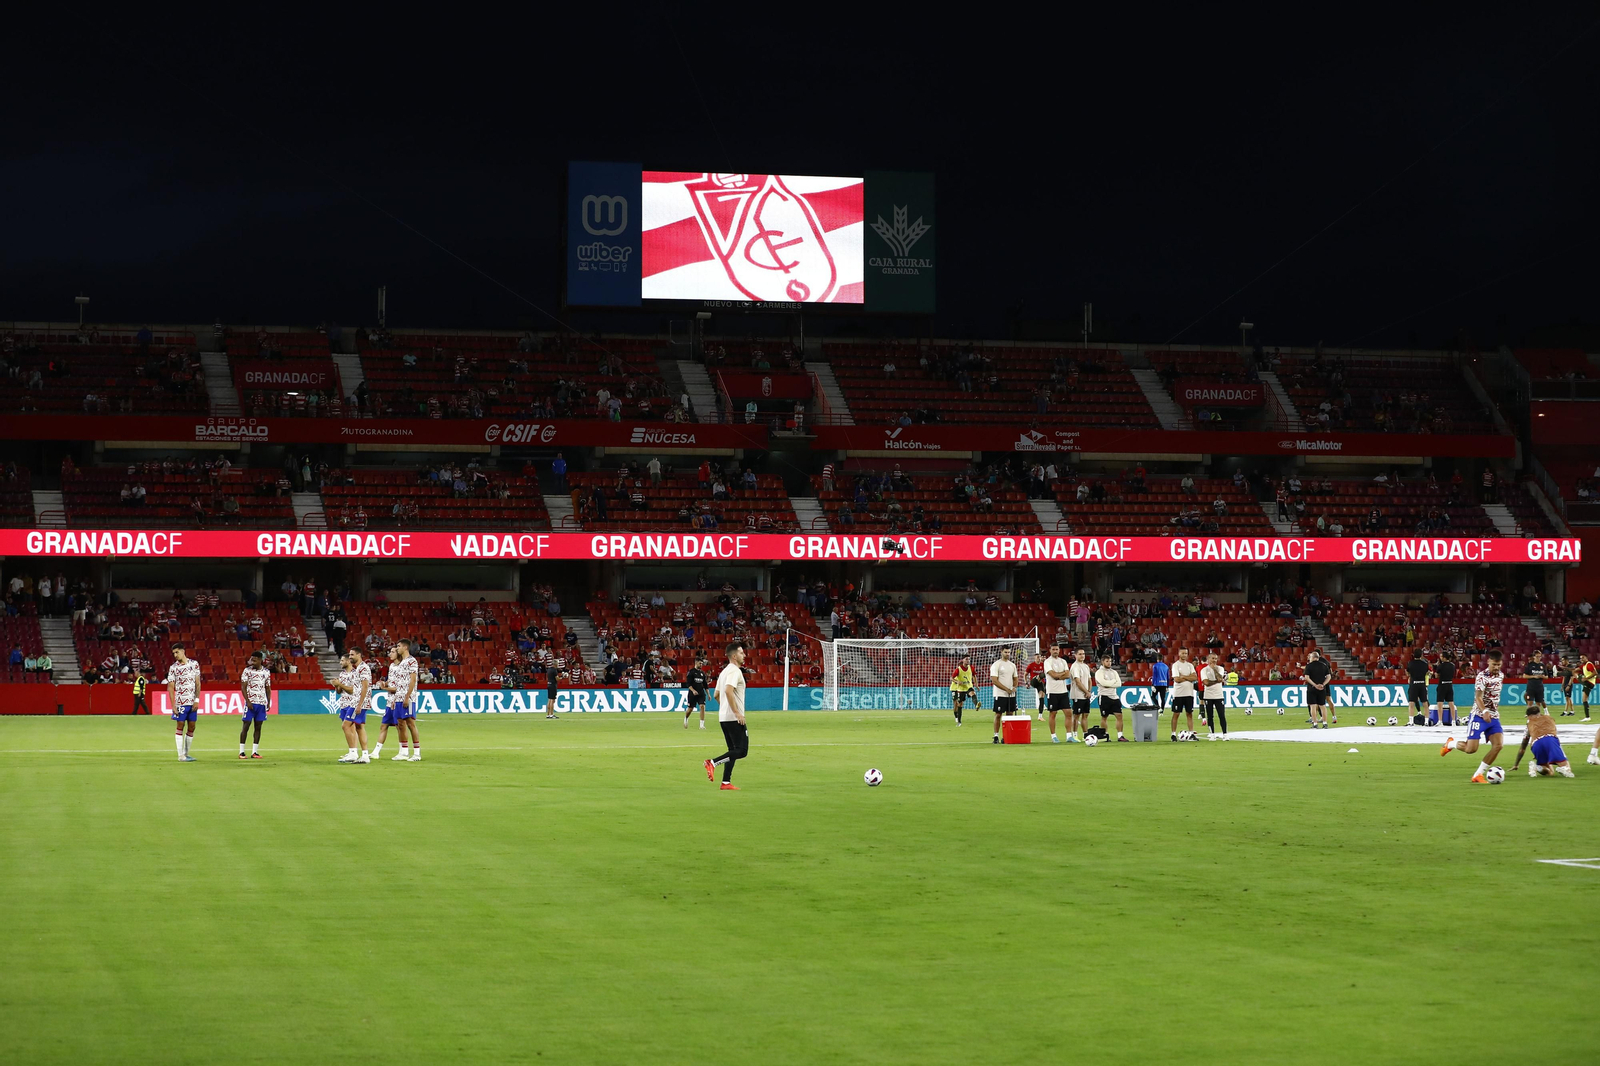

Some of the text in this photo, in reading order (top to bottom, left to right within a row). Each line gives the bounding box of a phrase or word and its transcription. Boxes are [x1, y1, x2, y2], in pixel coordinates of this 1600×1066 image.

[577, 242, 632, 262] wiber
[868, 257, 933, 268] CAJA RURAL
[245, 371, 326, 384] GRANADACF
[1185, 389, 1258, 400] GRANADACF
[207, 417, 258, 425] GRUPO
[195, 425, 269, 436] BARCALO
[341, 427, 414, 436] AUTOGRANADINA
[502, 424, 540, 442] CSIF
[643, 433, 697, 444] NUCESA
[885, 440, 922, 449] Halcón
[1296, 440, 1343, 450] MicaMotor
[26, 531, 182, 555] GRANADACF
[257, 533, 411, 556] GRANADACF
[591, 535, 748, 558] GRANADACF
[982, 537, 1132, 560] GRANADACF
[1170, 538, 1315, 560] GRANADACF
[1352, 539, 1492, 561] GRANADACF
[447, 691, 547, 713] RURAL
[554, 690, 698, 713] GRANADA
[1471, 721, 1481, 730] 18
